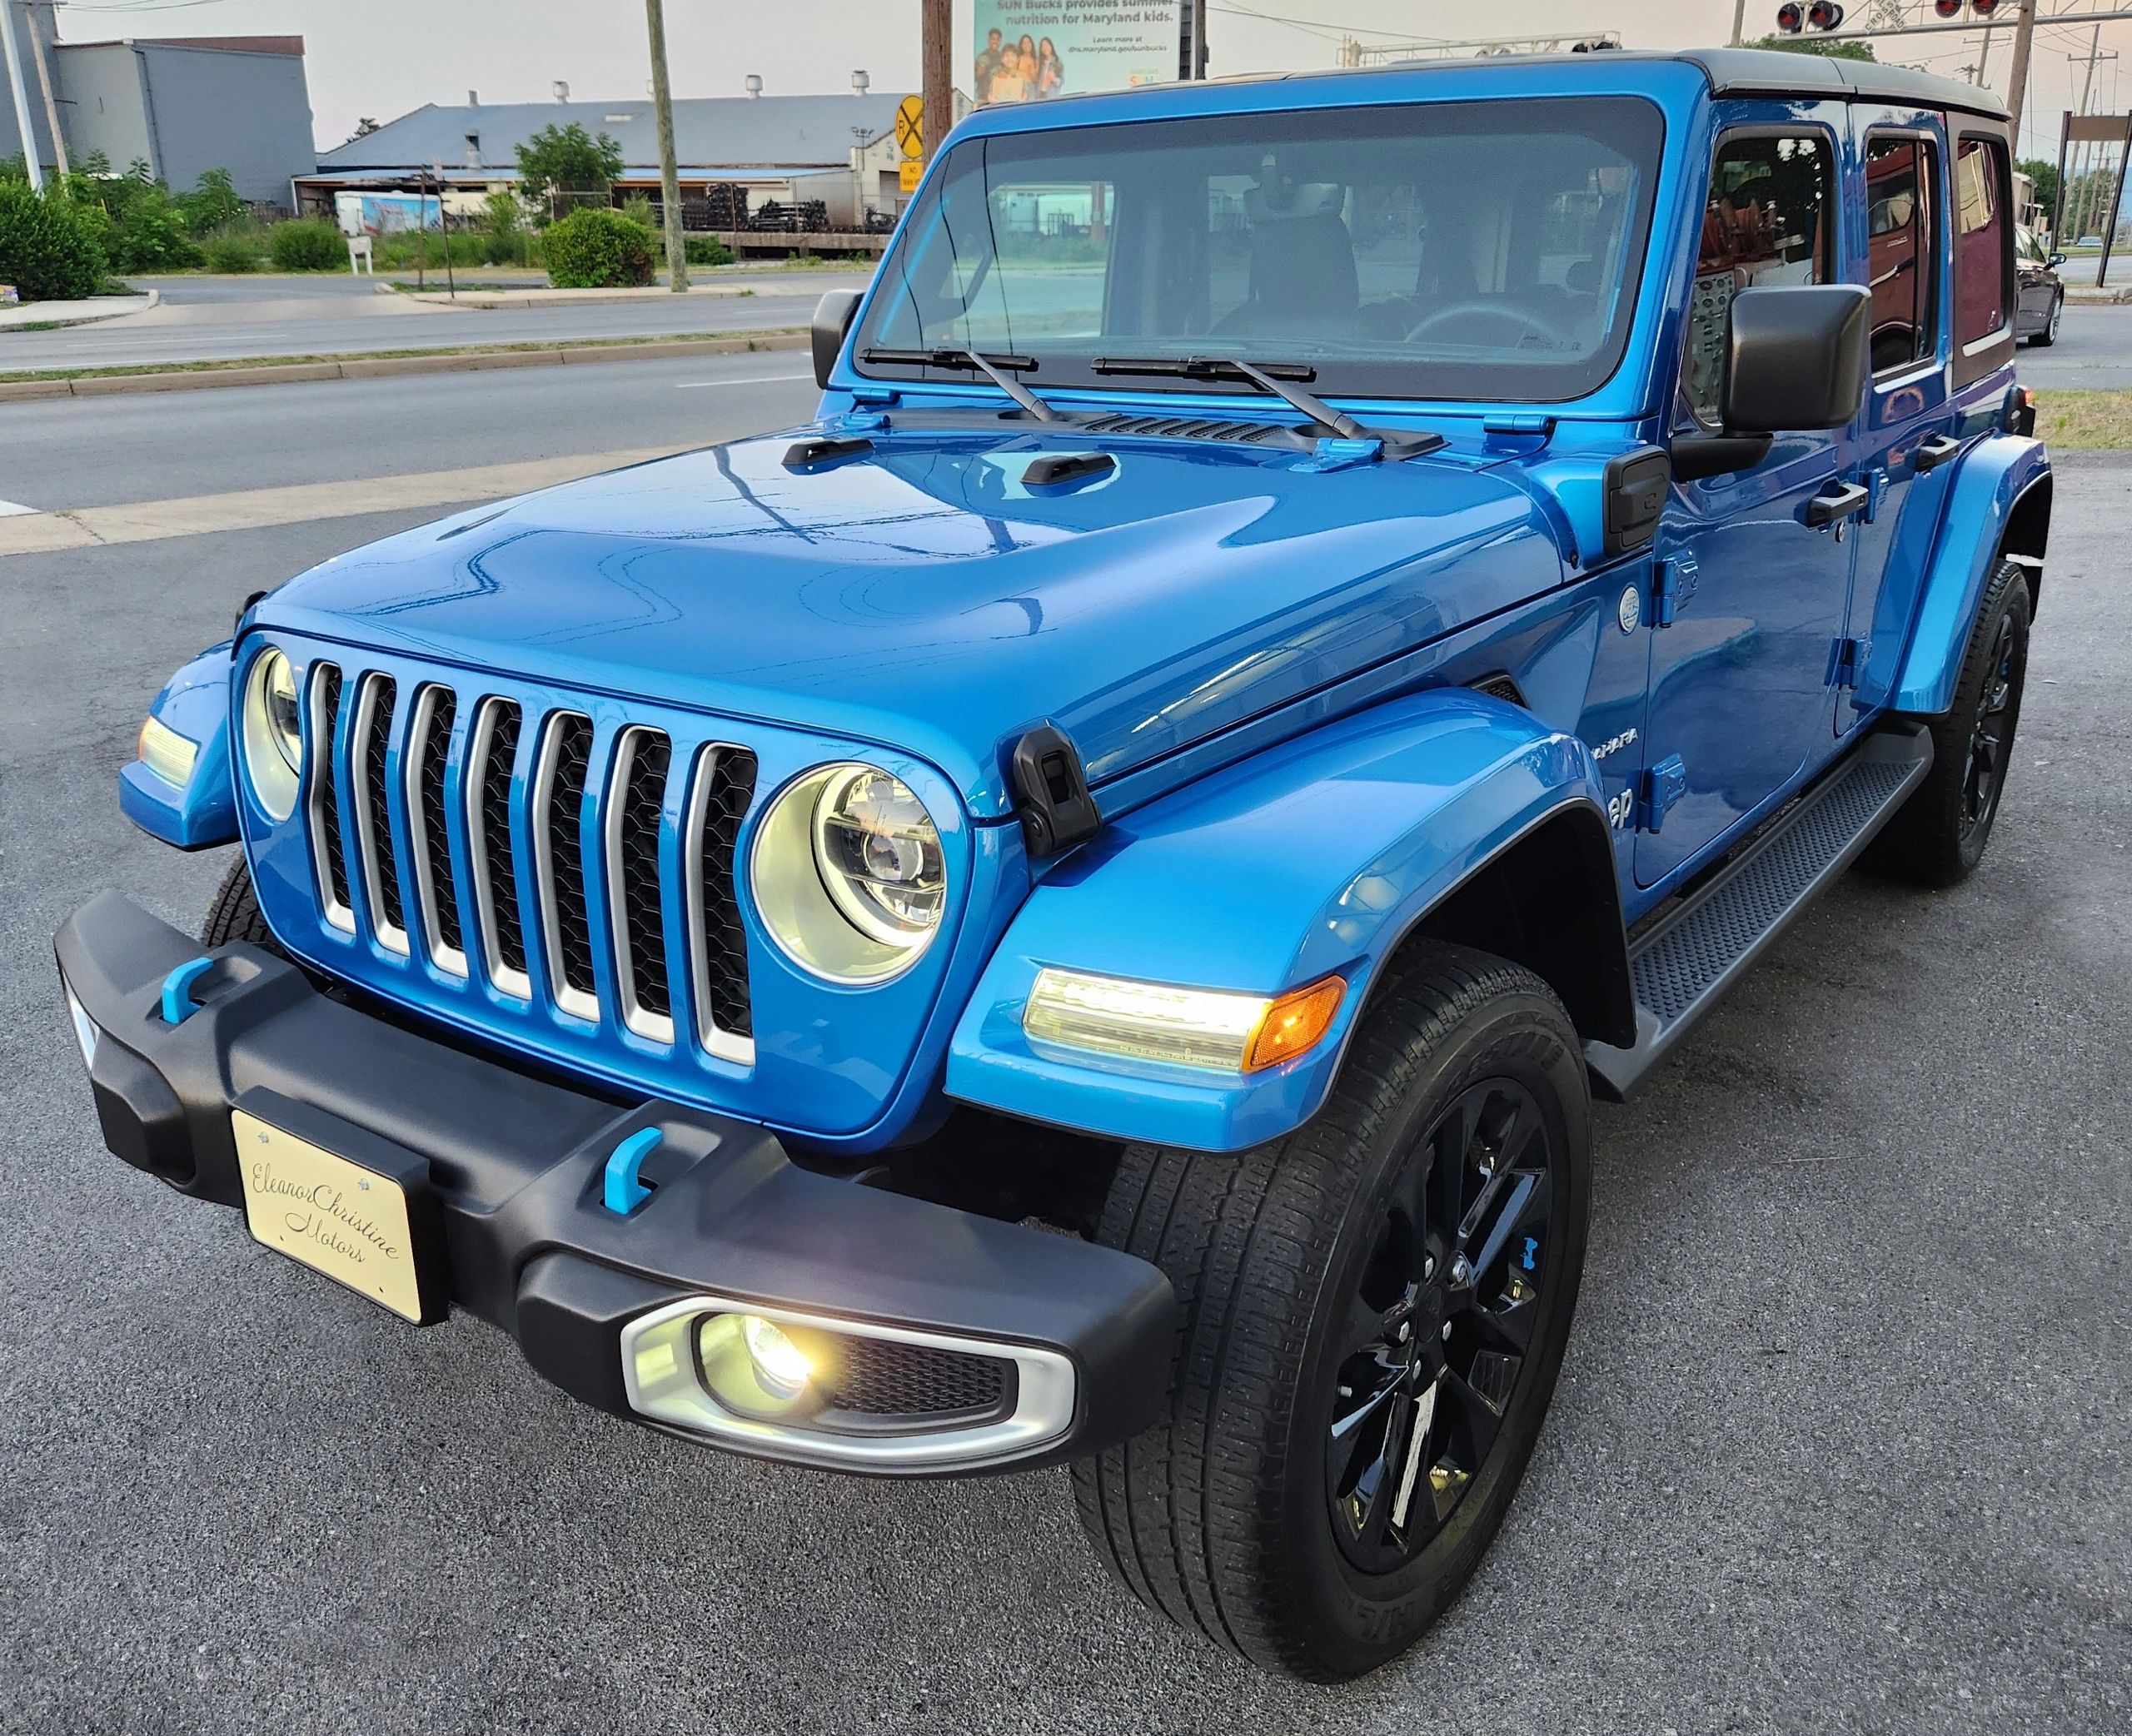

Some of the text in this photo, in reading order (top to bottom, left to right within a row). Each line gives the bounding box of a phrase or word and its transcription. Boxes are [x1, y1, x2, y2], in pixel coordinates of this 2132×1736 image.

[997, 0, 1022, 9] SUN
[1026, 0, 1063, 9] Bucks
[1066, 0, 1118, 11] provides
[1006, 11, 1173, 25] nutrition for Maryland kids.
[1591, 728, 1639, 760] AHARA
[1608, 788, 1632, 829] ep
